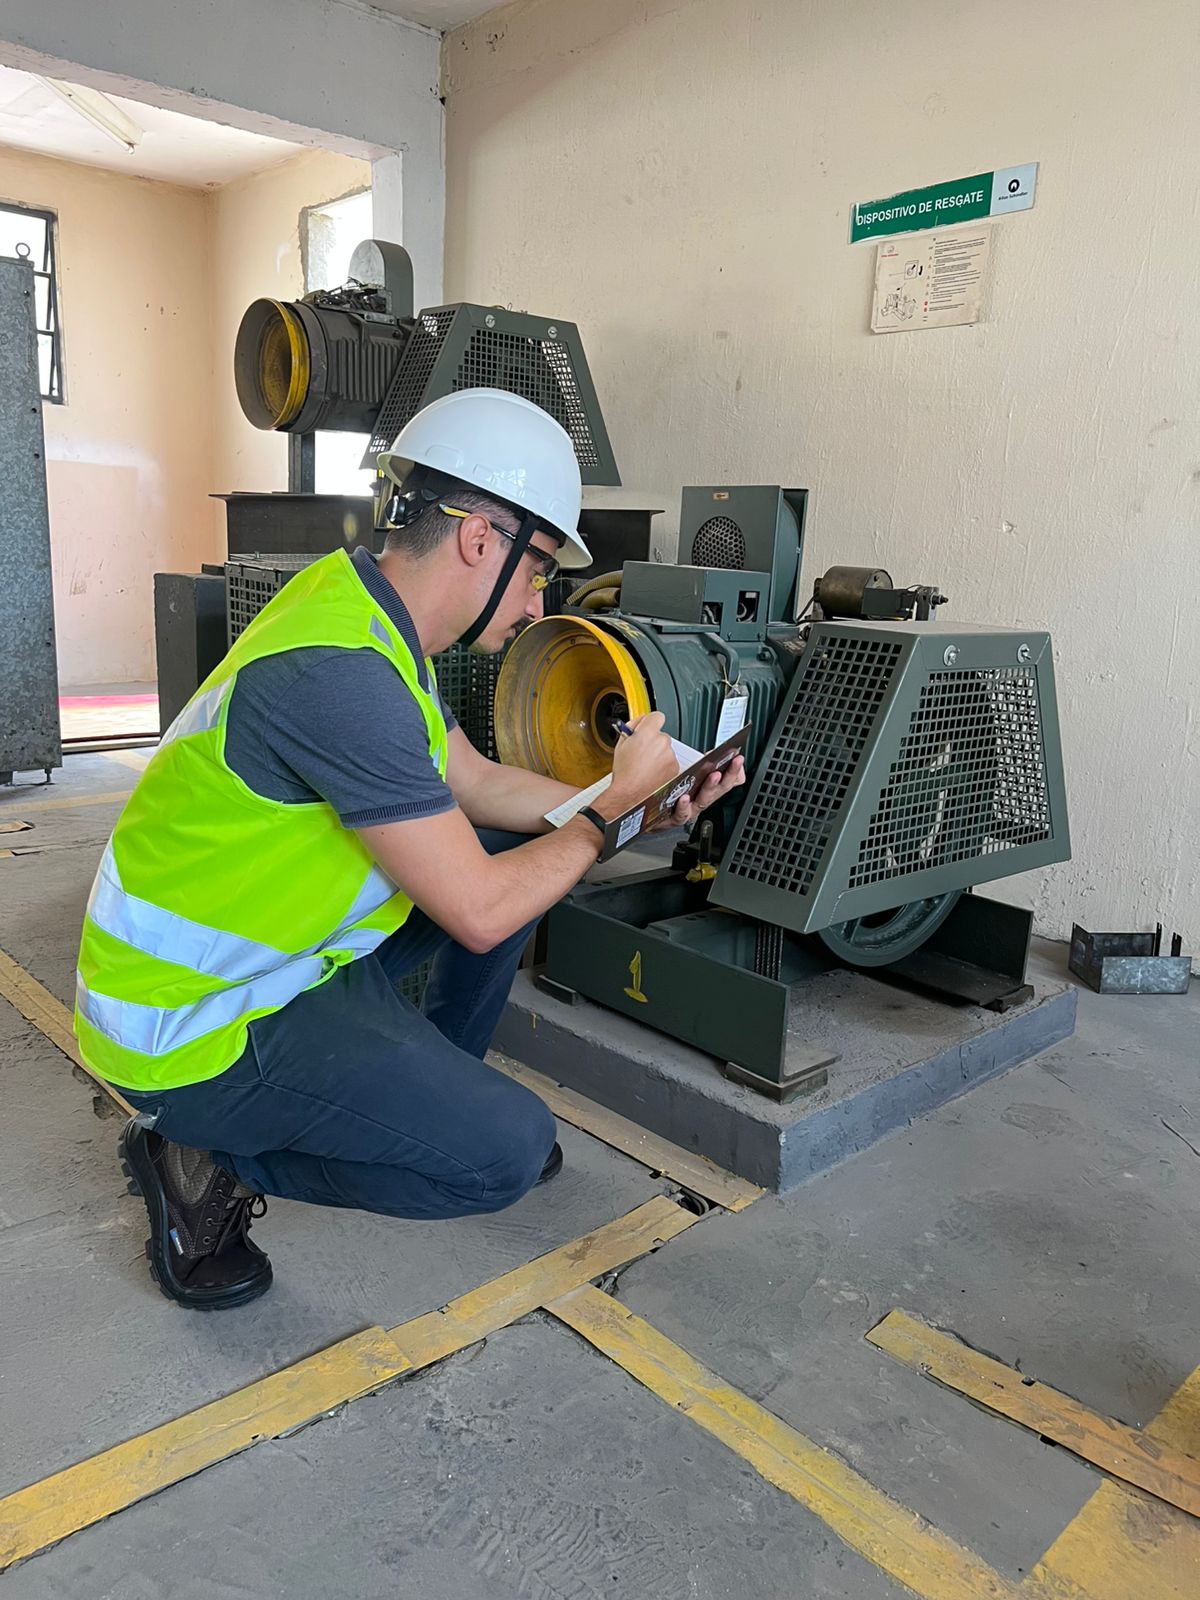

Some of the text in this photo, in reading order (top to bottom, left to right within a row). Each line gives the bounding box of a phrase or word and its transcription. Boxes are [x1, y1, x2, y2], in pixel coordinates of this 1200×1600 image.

[857, 204, 917, 226] DISPOSITIVO
[918, 201, 933, 214] DE
[935, 190, 984, 210] RESGATE
